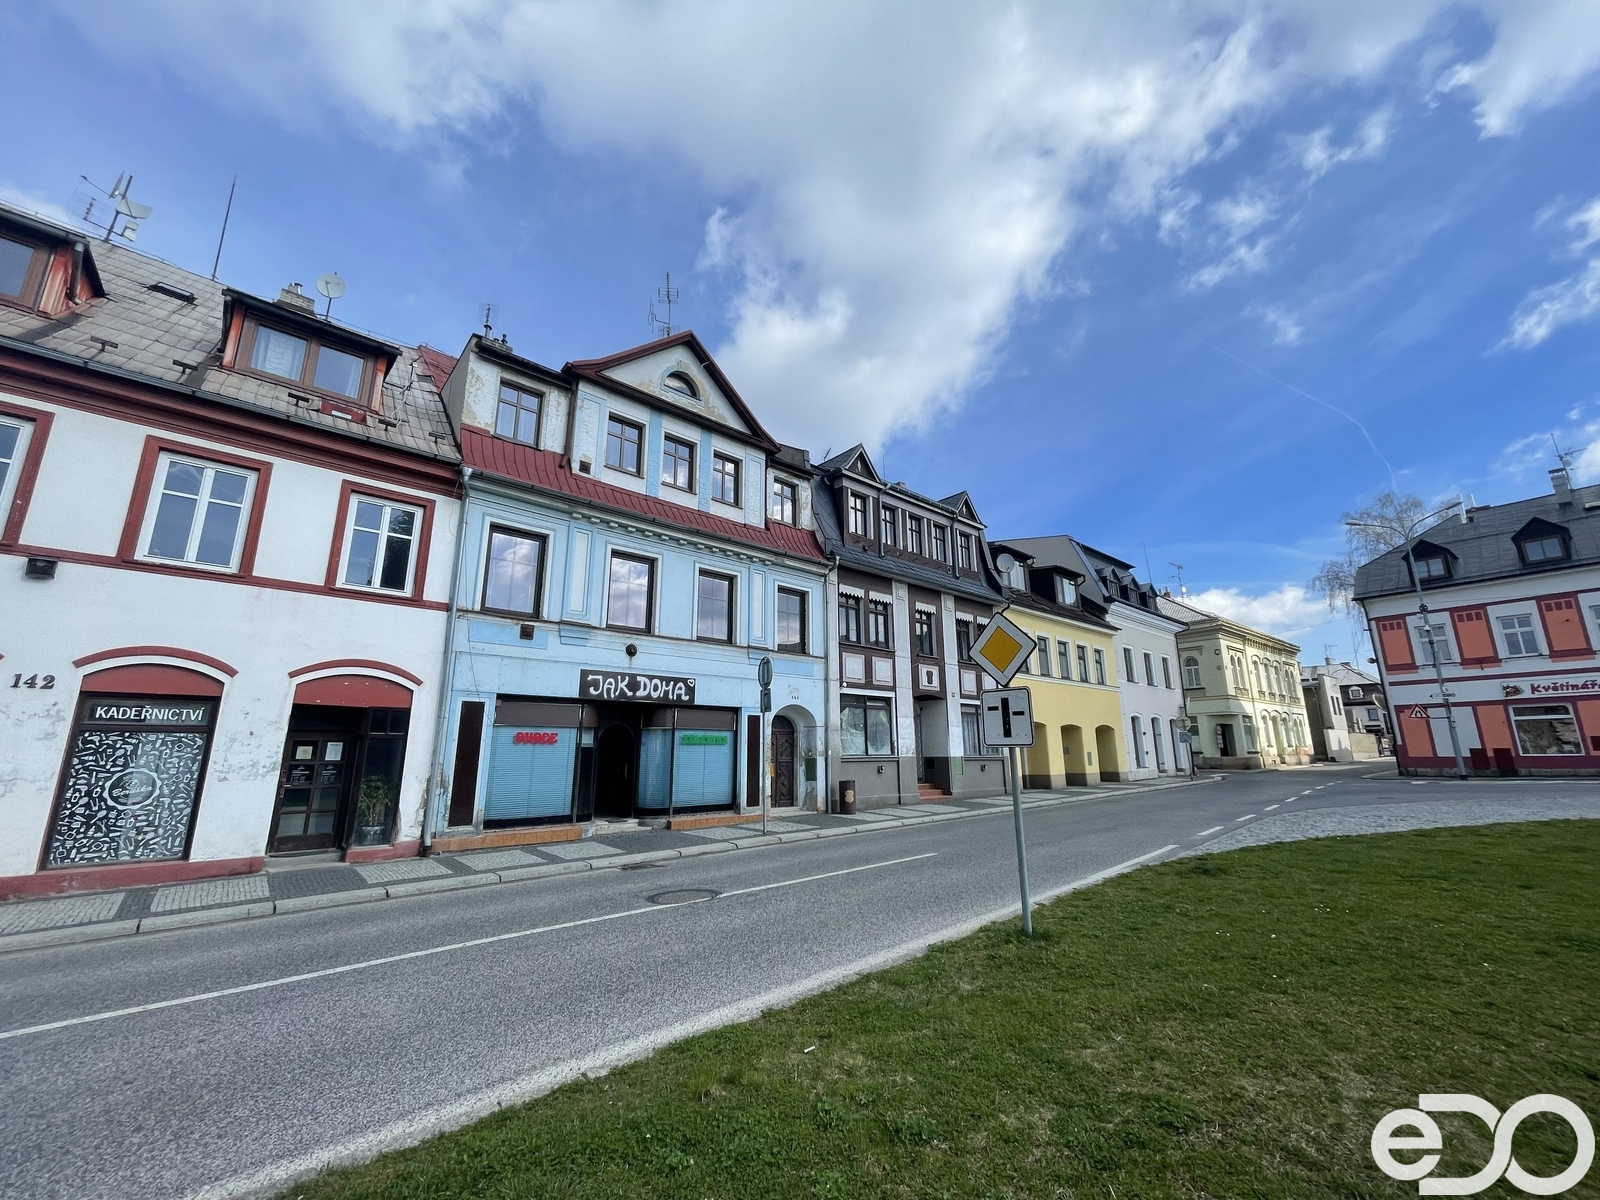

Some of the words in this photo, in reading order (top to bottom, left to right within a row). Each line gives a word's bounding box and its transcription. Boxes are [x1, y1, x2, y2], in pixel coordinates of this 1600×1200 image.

[10, 673, 56, 690] 142
[587, 675, 633, 699] JAK
[636, 676, 690, 701] DOMA
[1530, 679, 1600, 695] Květinář
[95, 705, 205, 721] KADEŘNICTVÍ
